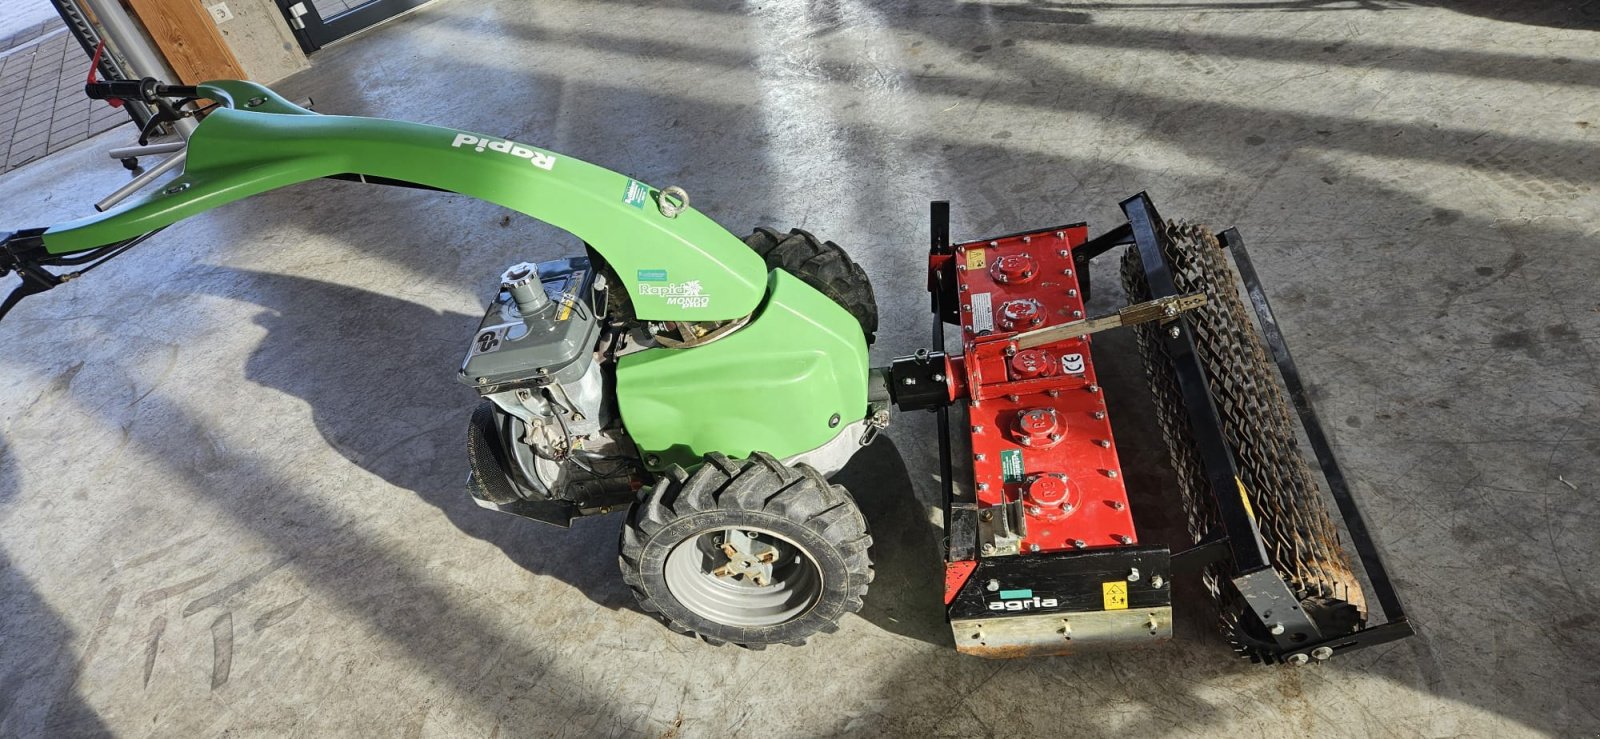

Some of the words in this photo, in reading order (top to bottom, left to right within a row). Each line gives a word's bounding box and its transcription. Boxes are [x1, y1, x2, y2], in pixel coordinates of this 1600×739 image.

[452, 133, 556, 170] Rapid
[638, 283, 687, 297] Rapid
[667, 297, 709, 305] MONDO
[1064, 354, 1082, 371] CE
[989, 596, 1058, 610] agria
